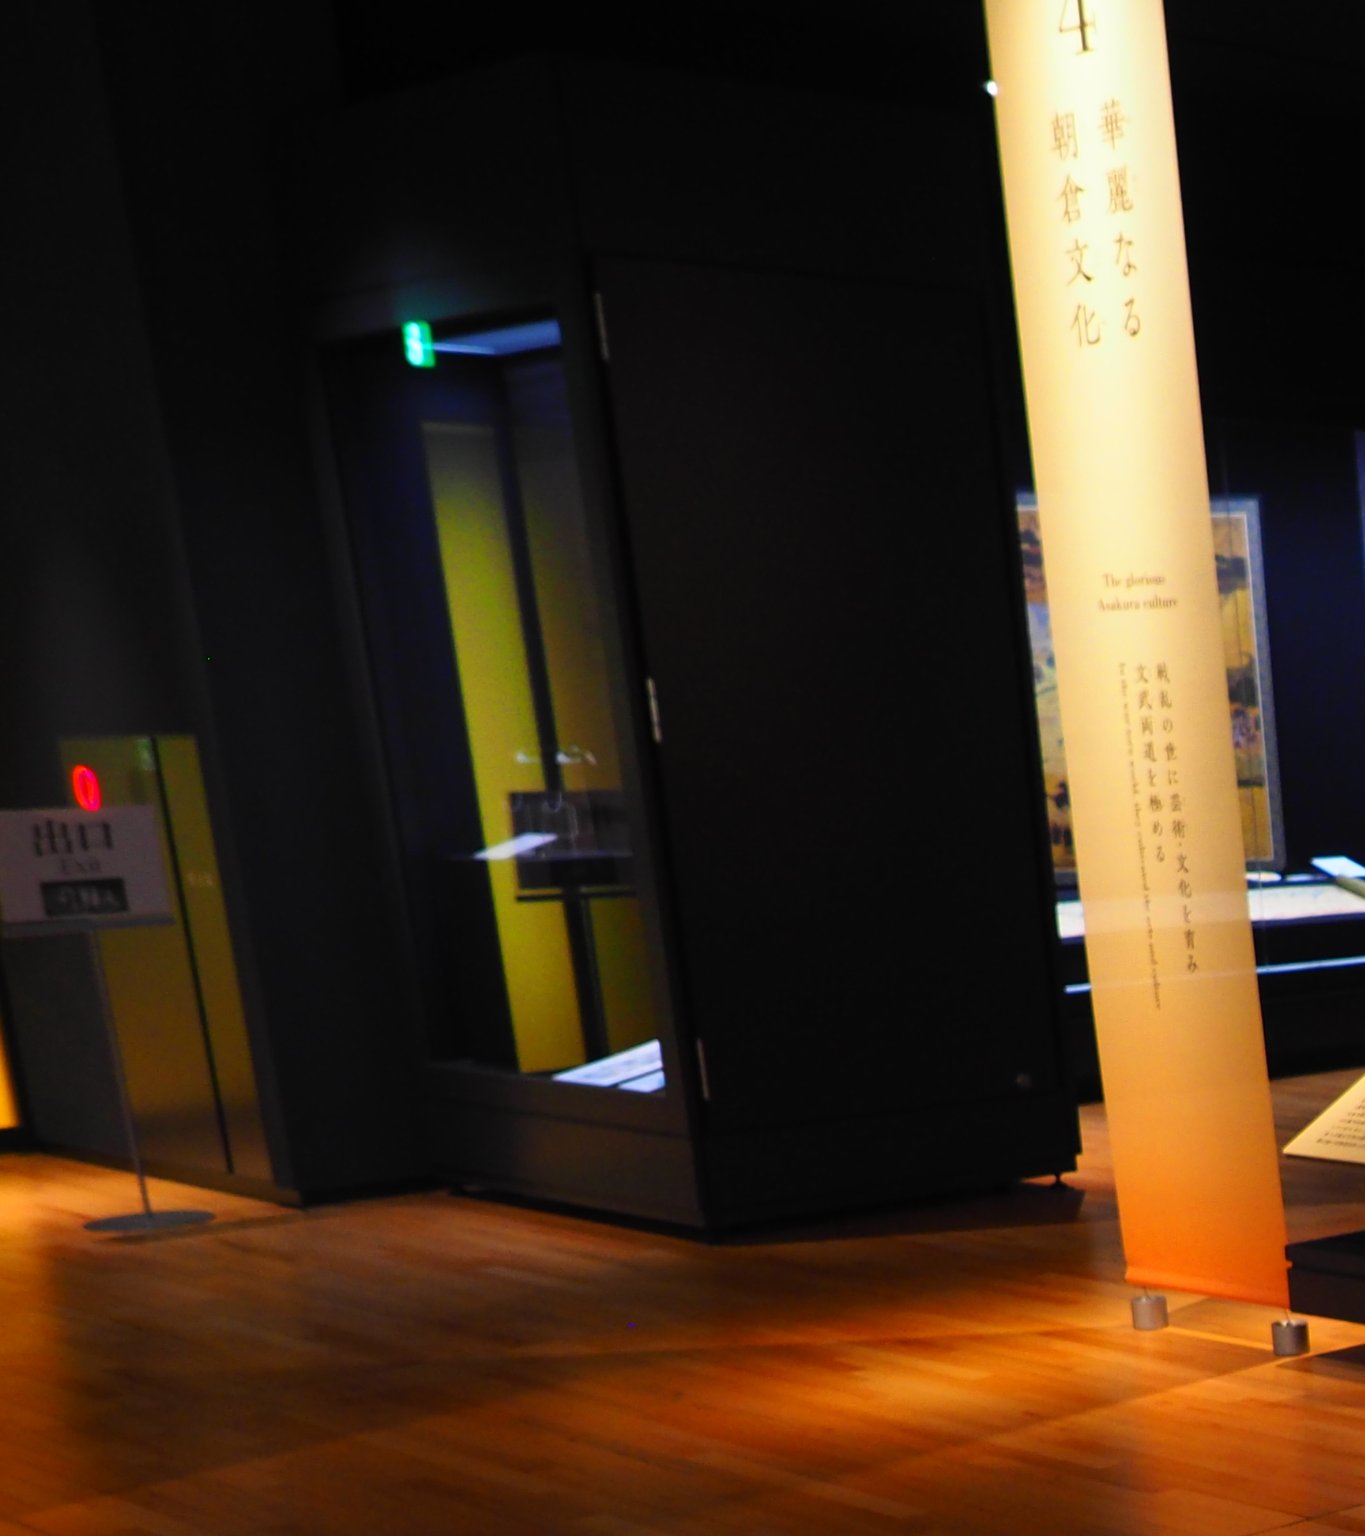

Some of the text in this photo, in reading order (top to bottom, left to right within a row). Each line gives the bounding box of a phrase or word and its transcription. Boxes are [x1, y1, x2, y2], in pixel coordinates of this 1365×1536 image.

[1049, 109, 1101, 349] 朝倉文化
[1098, 97, 1141, 338] 華麗なる
[1102, 573, 1121, 589] The
[1143, 595, 1179, 611] culture
[1136, 662, 1167, 864] 文武両道を極める
[33, 820, 114, 856] 出口
